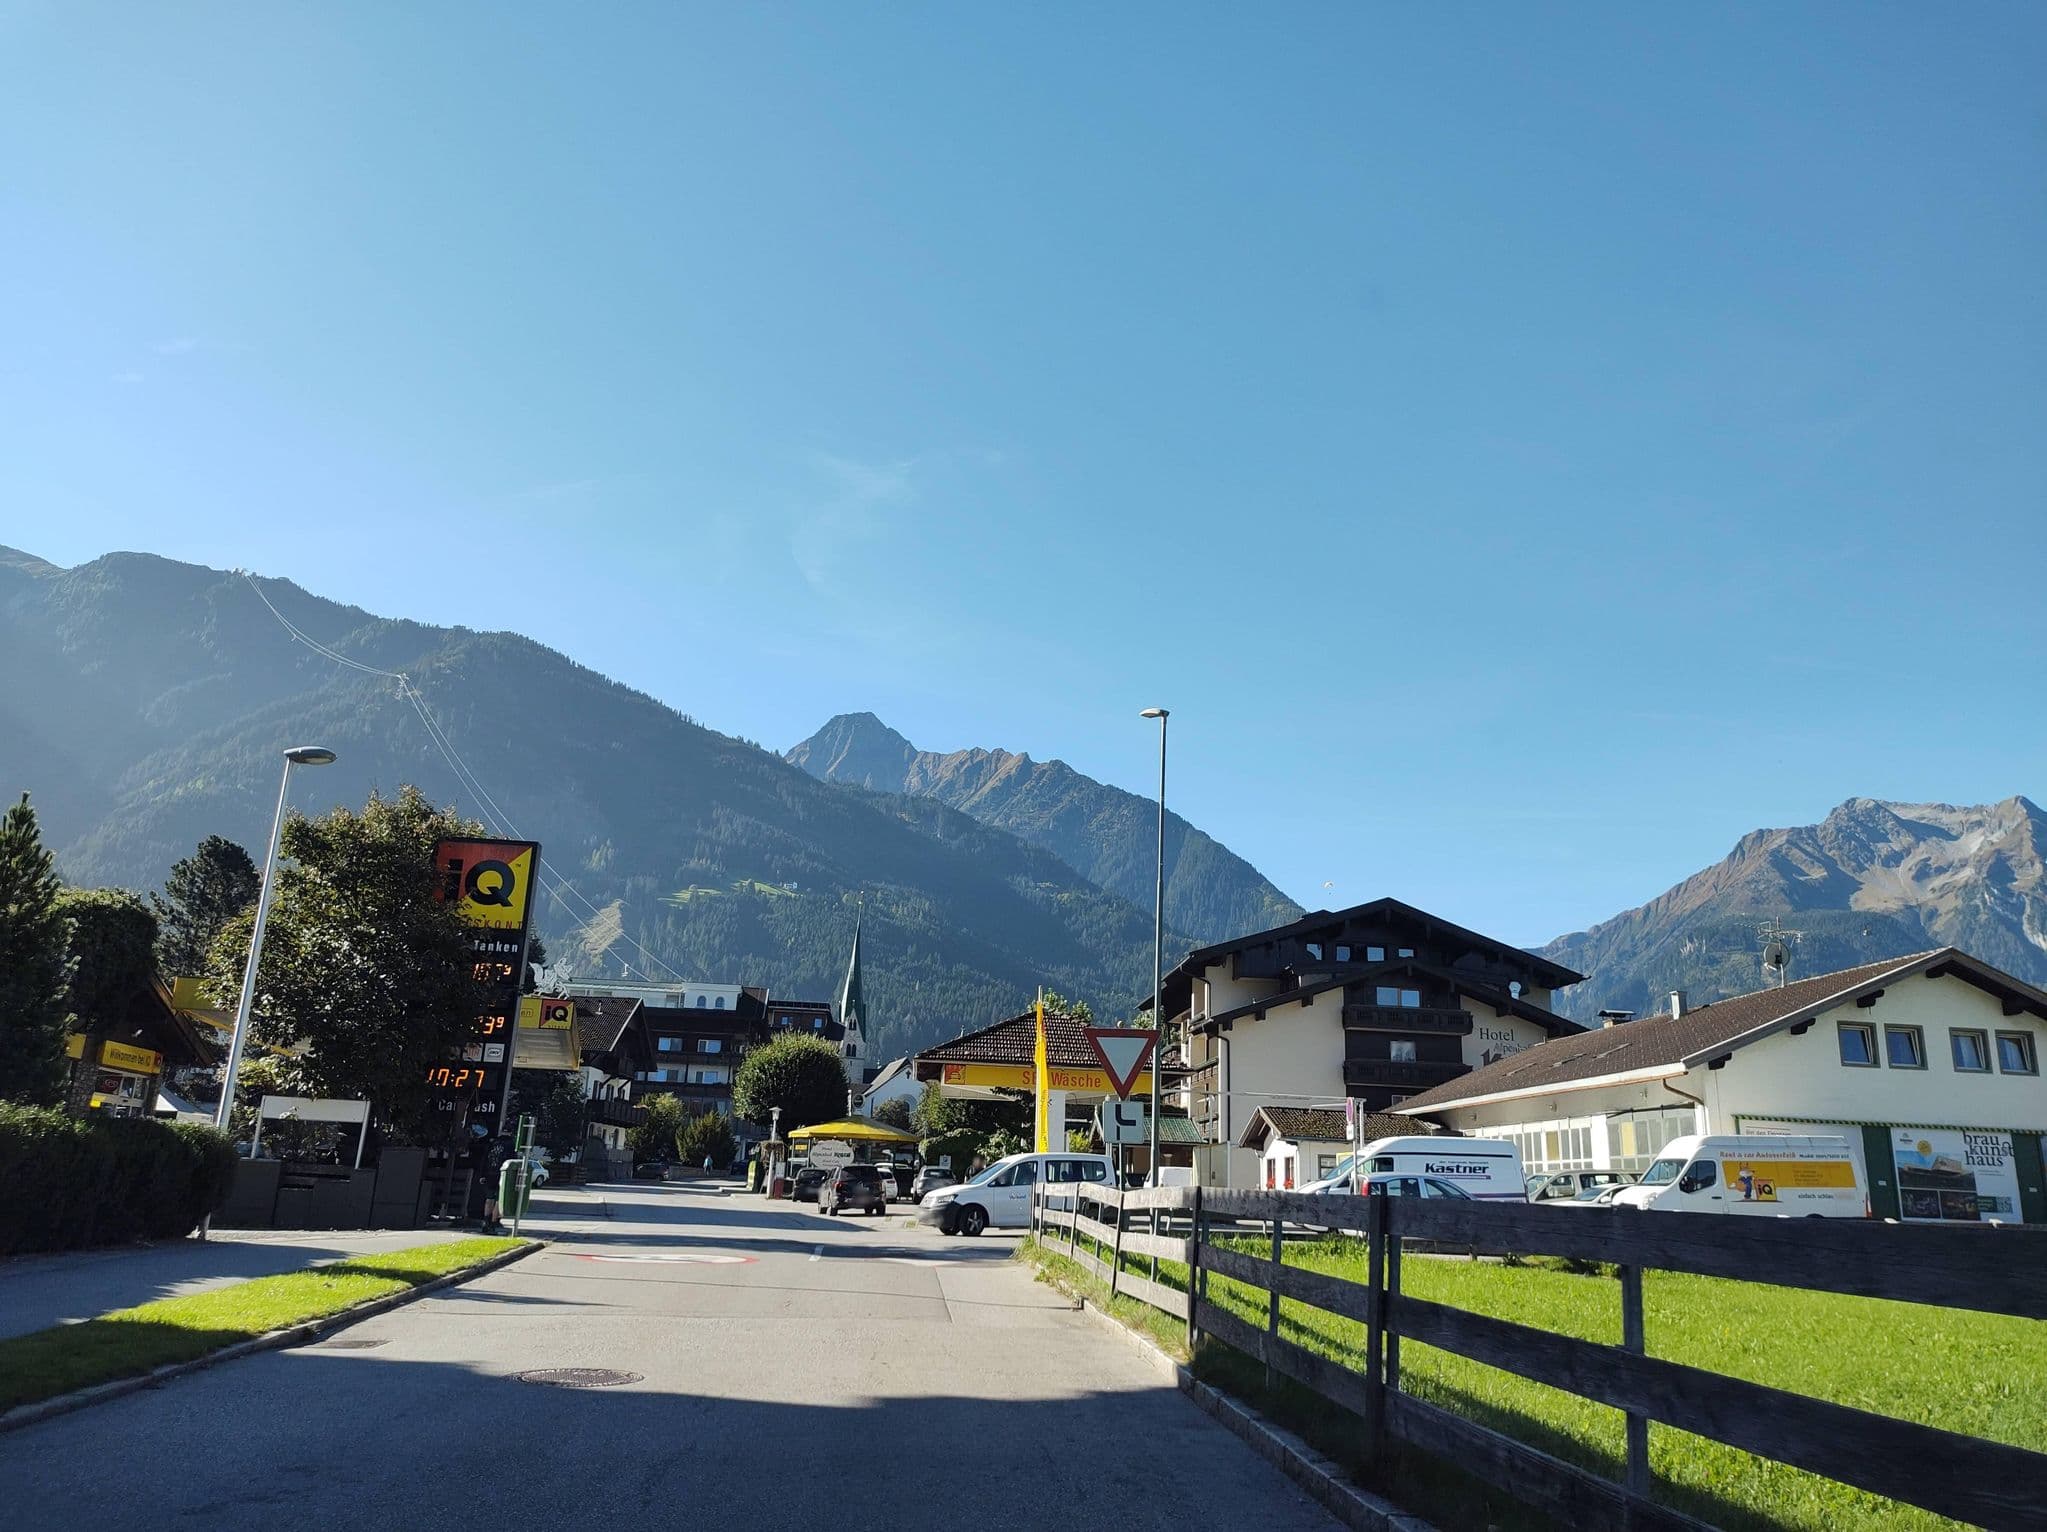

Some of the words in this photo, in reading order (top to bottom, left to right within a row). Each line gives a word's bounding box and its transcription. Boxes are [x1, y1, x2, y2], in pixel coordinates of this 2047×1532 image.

[473, 939, 519, 953] Tanken
[544, 1005, 569, 1022] iQ
[1479, 1027, 1515, 1042] Hotel
[1051, 1072, 1101, 1088] Wäsche
[1962, 1130, 2000, 1145] brau
[1969, 1141, 2015, 1158] kunst
[1964, 1150, 2004, 1167] haus
[1425, 1162, 1489, 1174] Kastner
[1757, 1183, 1773, 1196] iQ
